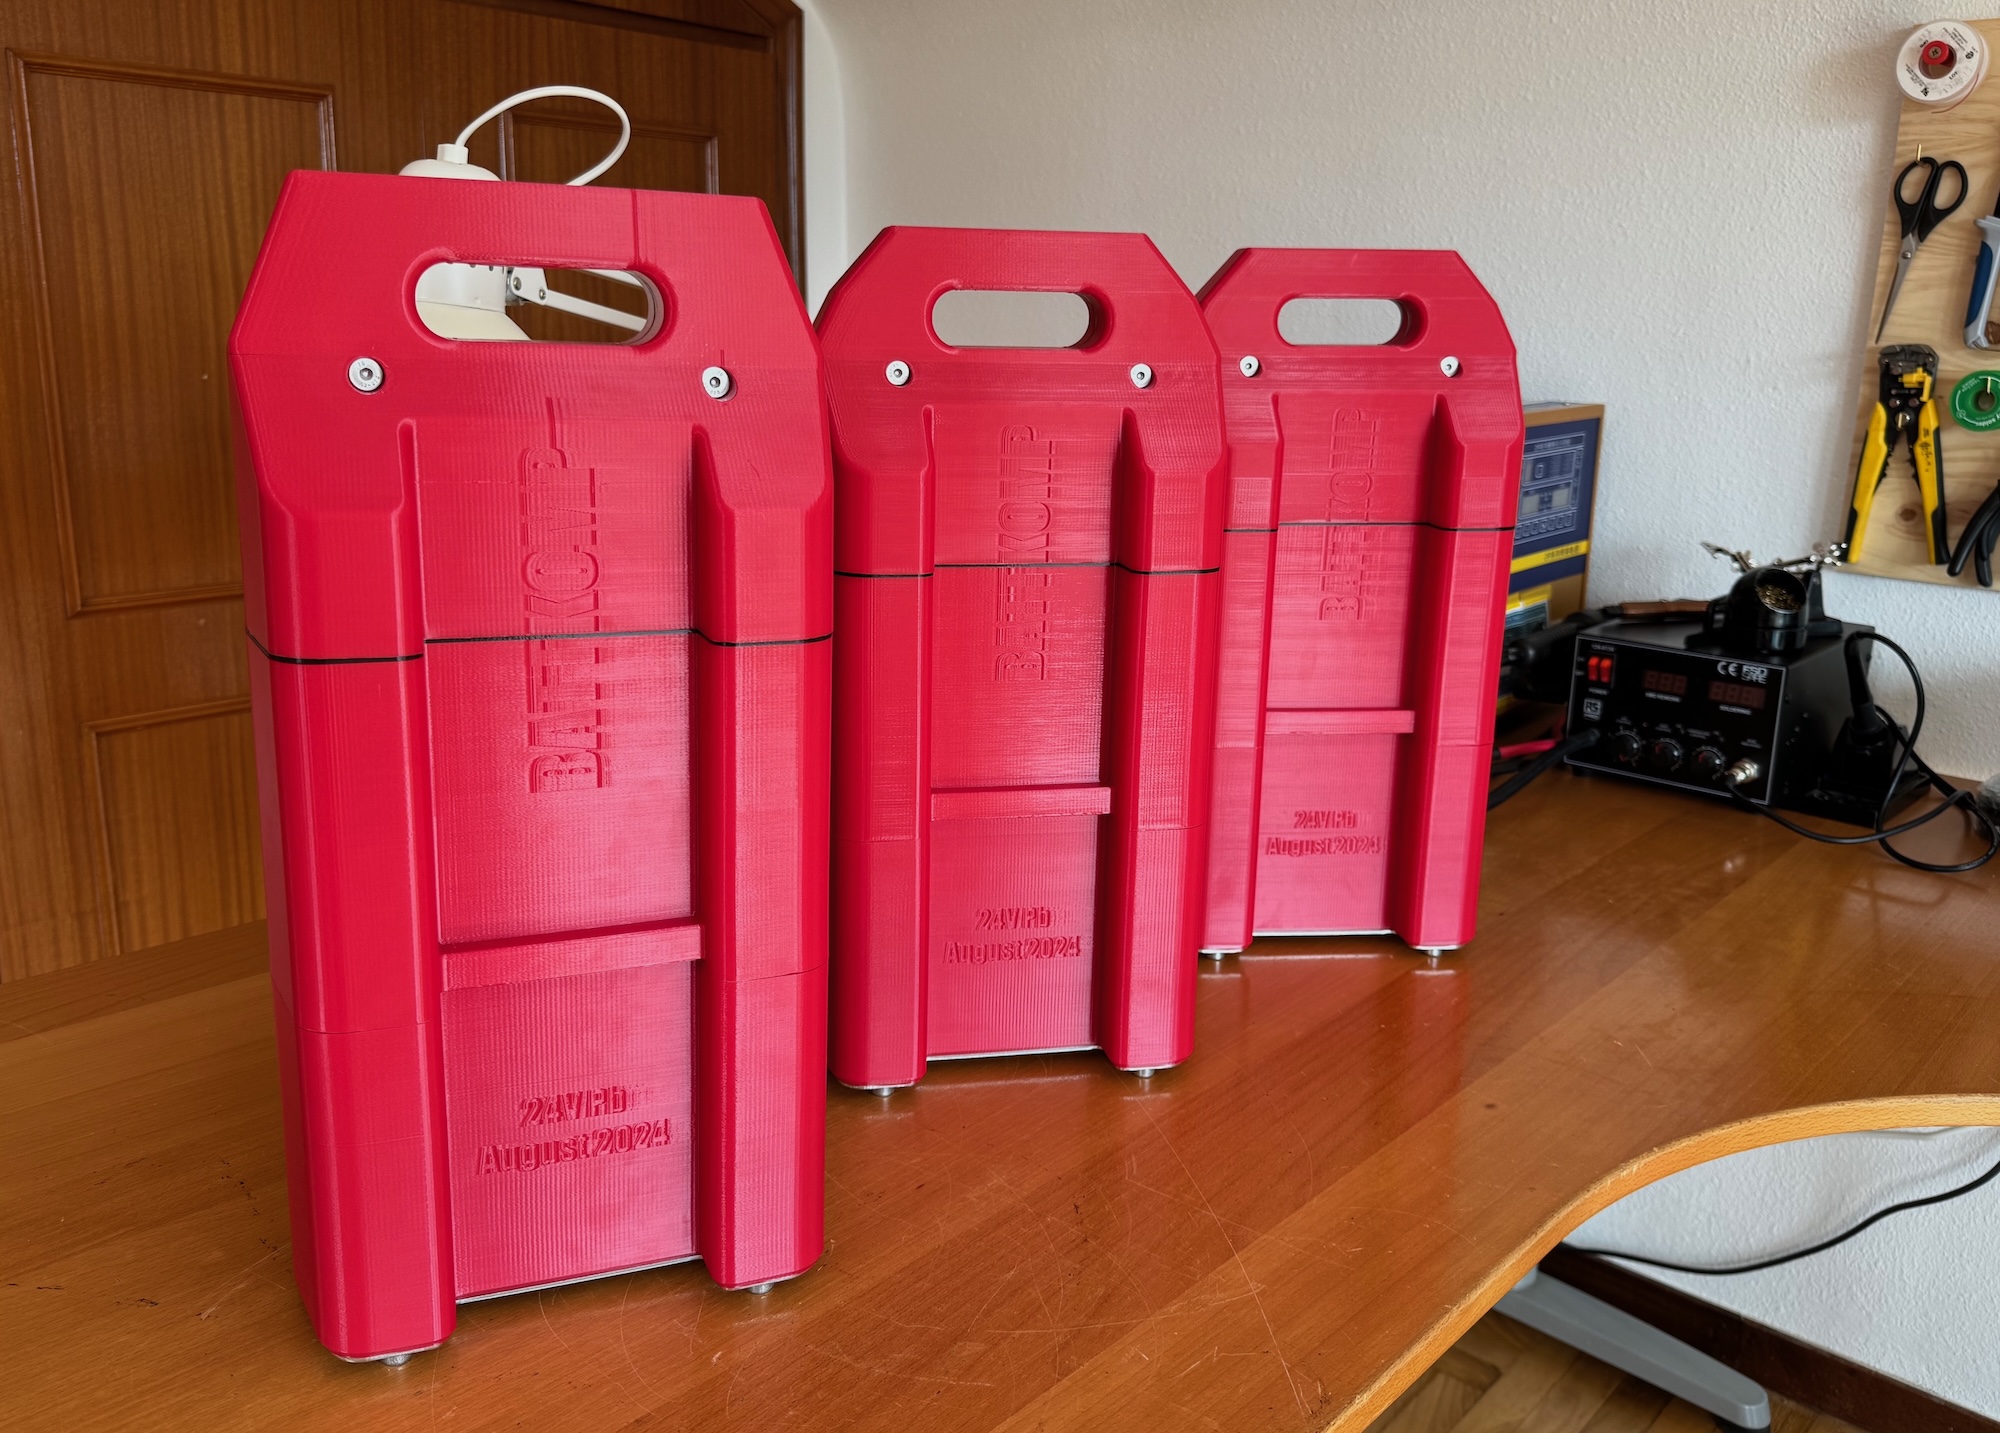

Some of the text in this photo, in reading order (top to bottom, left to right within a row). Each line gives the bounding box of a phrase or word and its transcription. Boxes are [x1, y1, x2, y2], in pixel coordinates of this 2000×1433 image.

[995, 424, 1053, 680] BATTKOMP
[521, 447, 604, 793] BATTKOMP
[1585, 700, 1600, 713] RS
[1294, 810, 1357, 829] 24V Pb
[1265, 835, 1380, 858] August 2024
[976, 906, 1051, 930] 24V Pb
[943, 935, 1082, 965] August 2024
[520, 1085, 628, 1127] 24V Pb
[477, 1118, 672, 1175] August 2024
